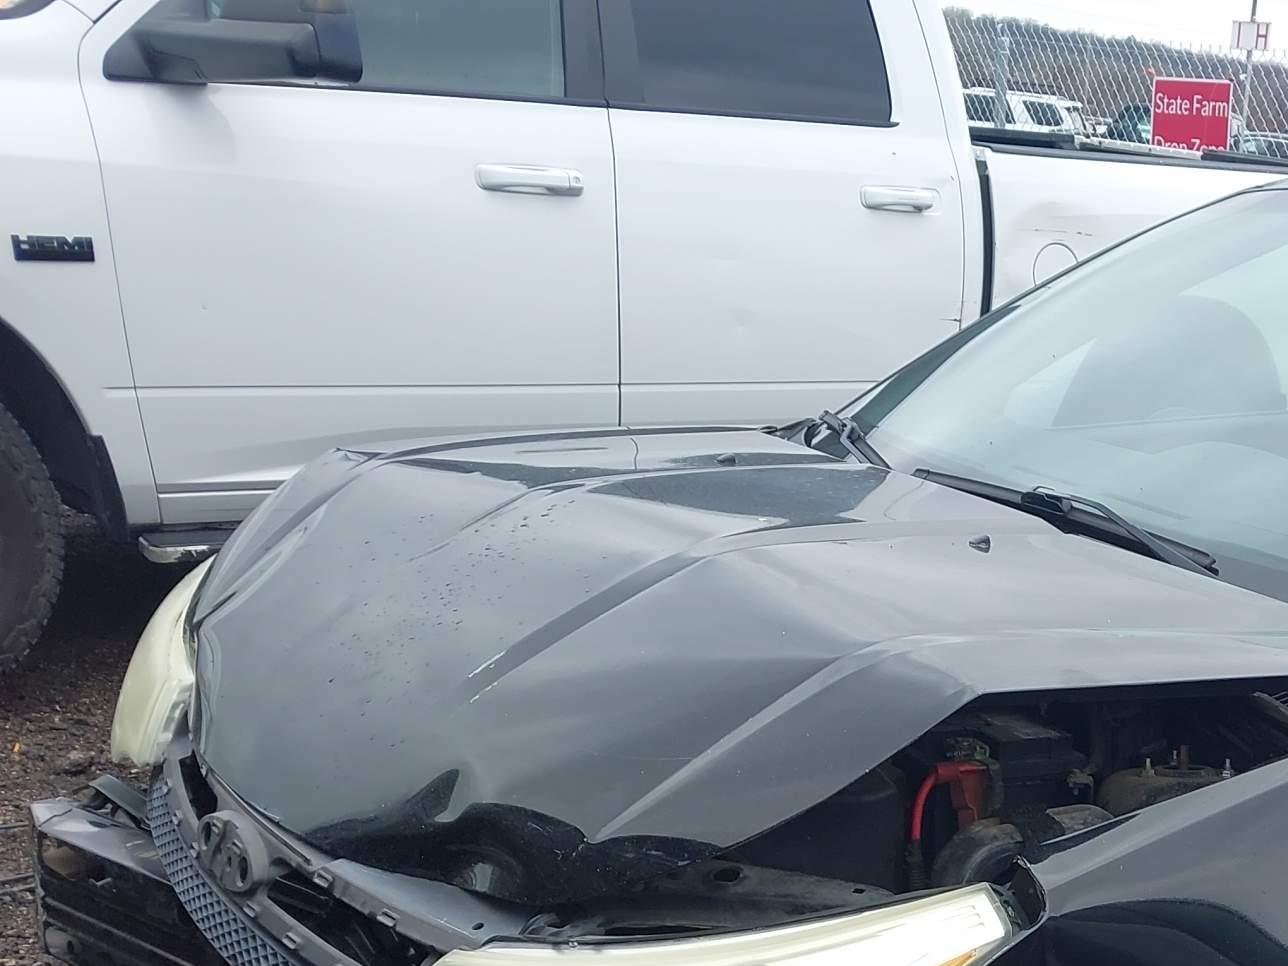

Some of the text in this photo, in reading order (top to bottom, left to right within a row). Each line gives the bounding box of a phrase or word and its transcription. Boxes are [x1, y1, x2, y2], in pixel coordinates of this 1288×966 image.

[1155, 92, 1228, 118] State Farm
[11, 234, 94, 256] HEMI
